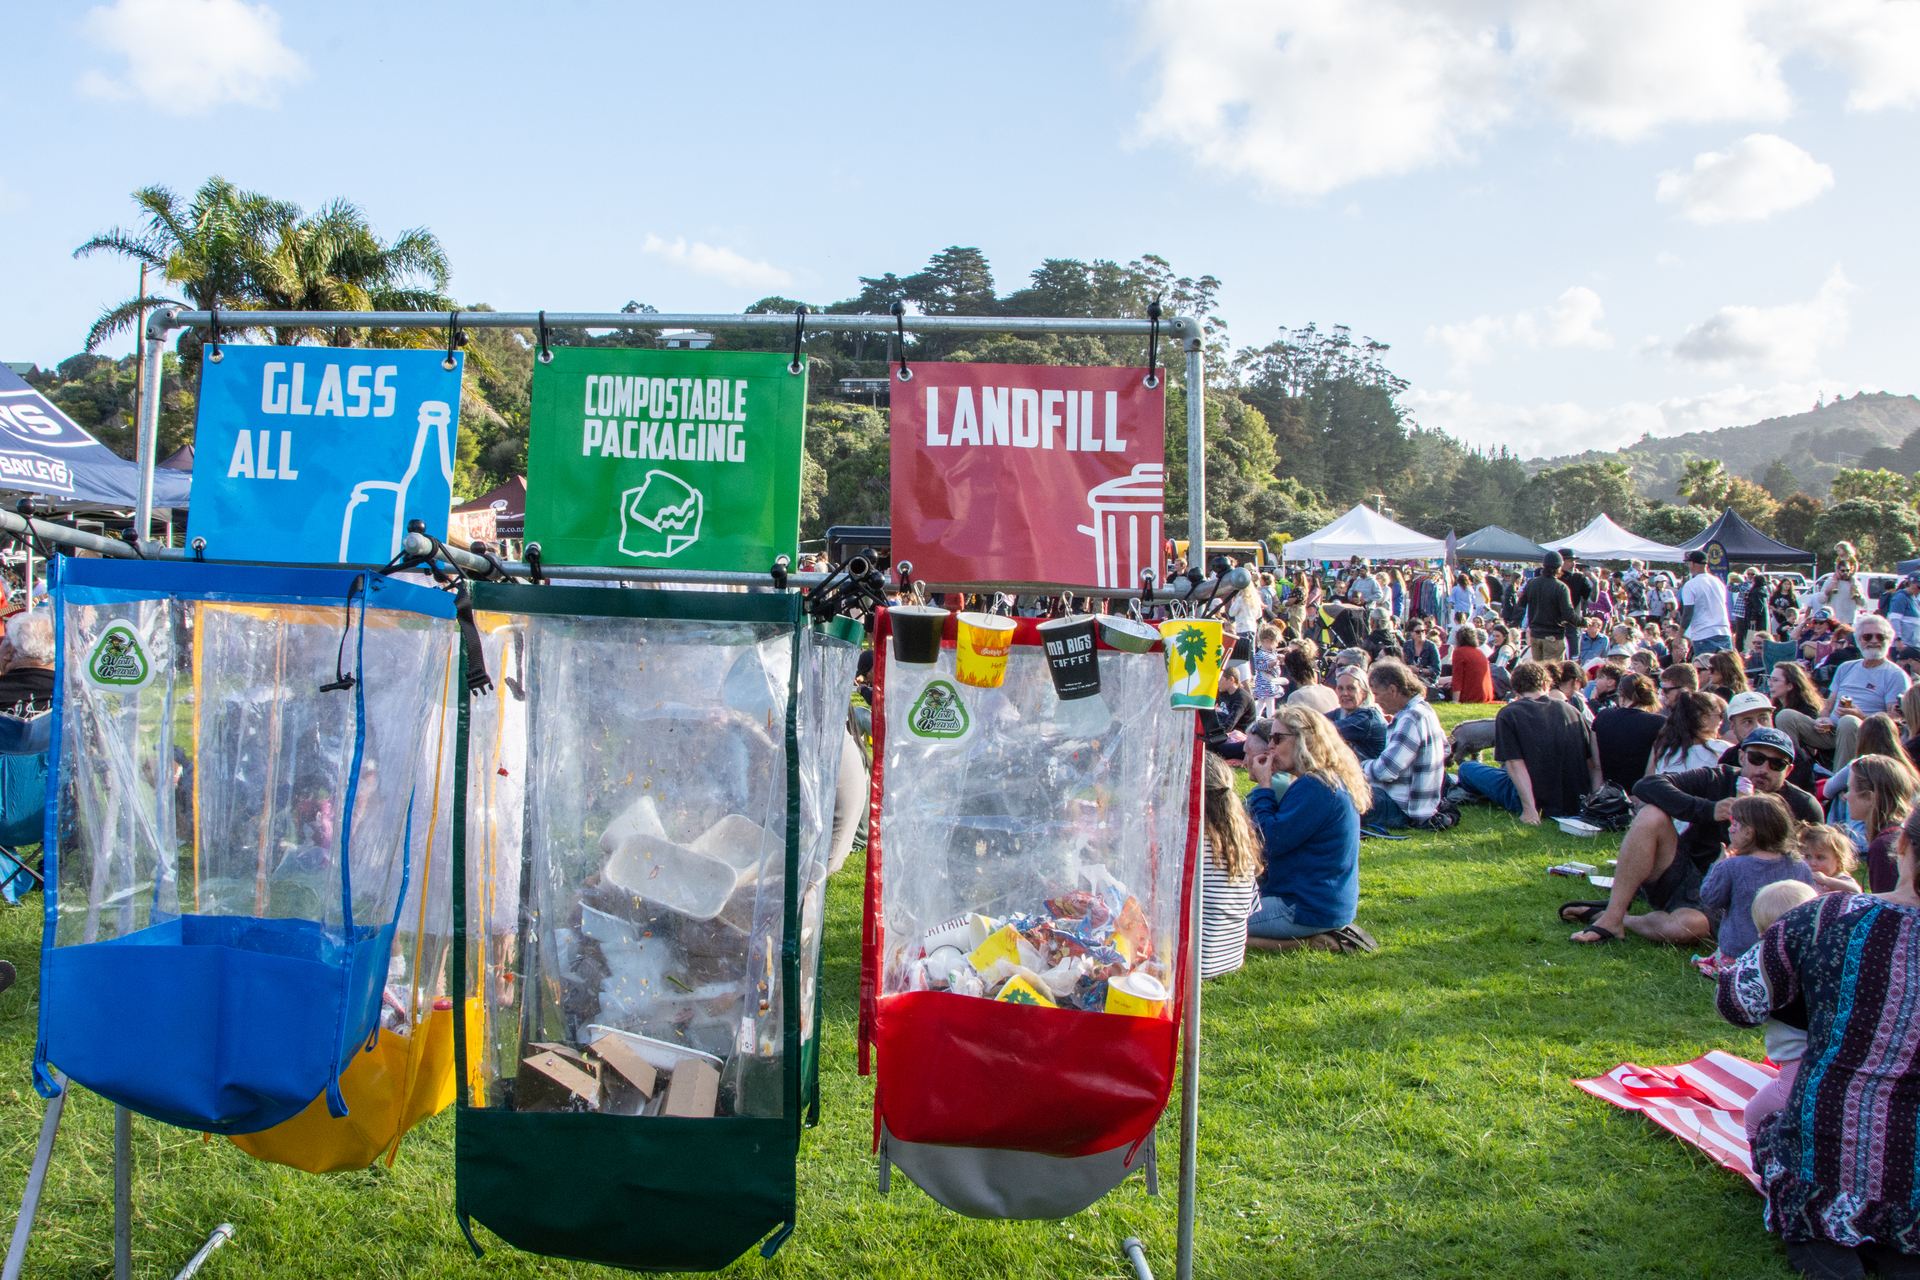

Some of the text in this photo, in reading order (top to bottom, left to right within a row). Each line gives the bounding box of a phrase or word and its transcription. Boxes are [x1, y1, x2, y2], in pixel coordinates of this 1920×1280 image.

[261, 361, 398, 418] GLASS
[584, 374, 748, 421] COMPOSTABLE
[0, 404, 63, 435] YS
[926, 386, 1127, 452] LANDFILL
[227, 429, 299, 481] ALL
[582, 419, 746, 463] PACKAGING
[0, 456, 68, 484] BAYLEYS
[99, 665, 139, 678] Wizards
[102, 654, 133, 666] Waste
[1052, 653, 1091, 668] COFFEE
[918, 718, 959, 730] Wizards
[922, 707, 953, 719] Waste
